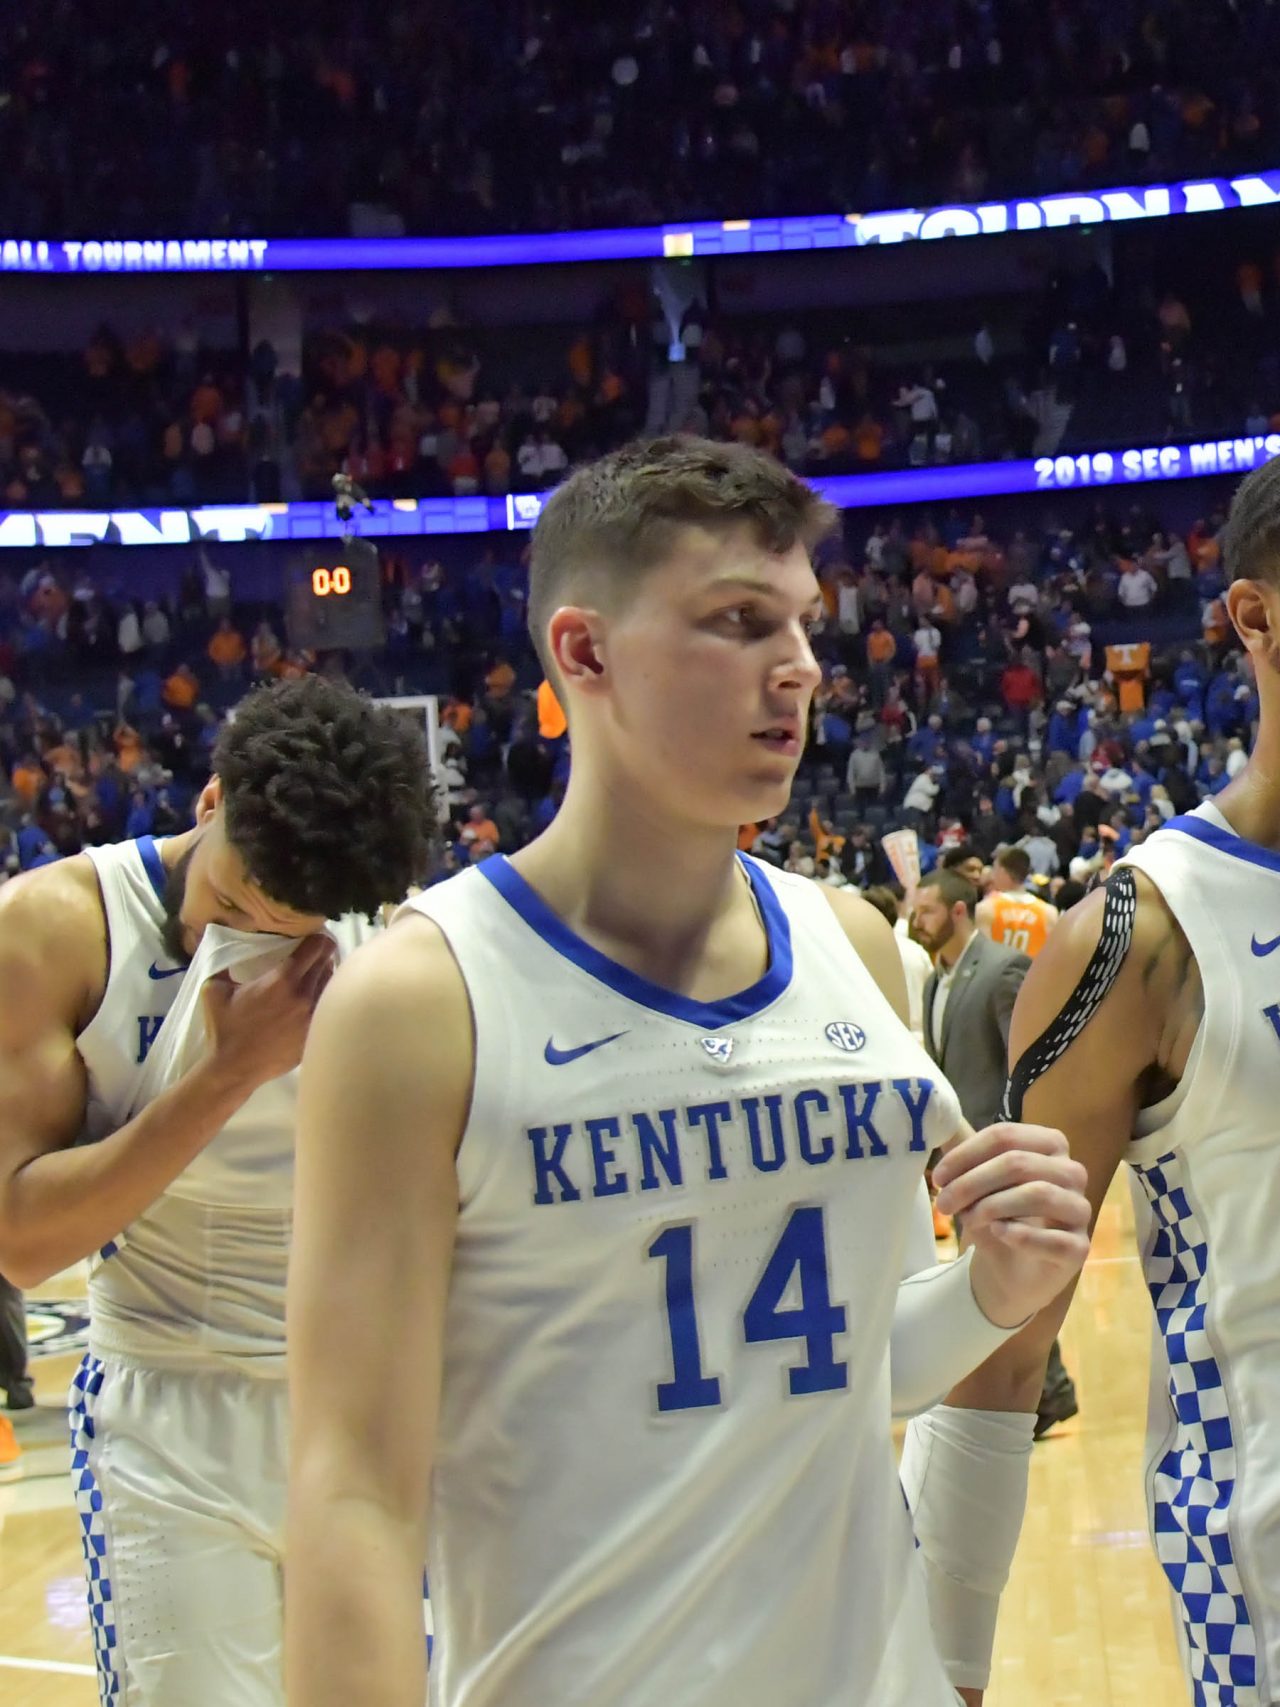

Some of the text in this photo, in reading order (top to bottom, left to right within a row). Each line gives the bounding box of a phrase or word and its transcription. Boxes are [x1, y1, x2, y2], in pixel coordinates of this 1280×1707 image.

[62, 239, 268, 271] TOURNAMENT
[1034, 452, 1114, 488] 2019
[1122, 446, 1181, 481] SEC
[826, 1023, 865, 1051] SEC
[527, 1077, 936, 1206] KENTUCKY
[646, 1206, 848, 1413] 14
